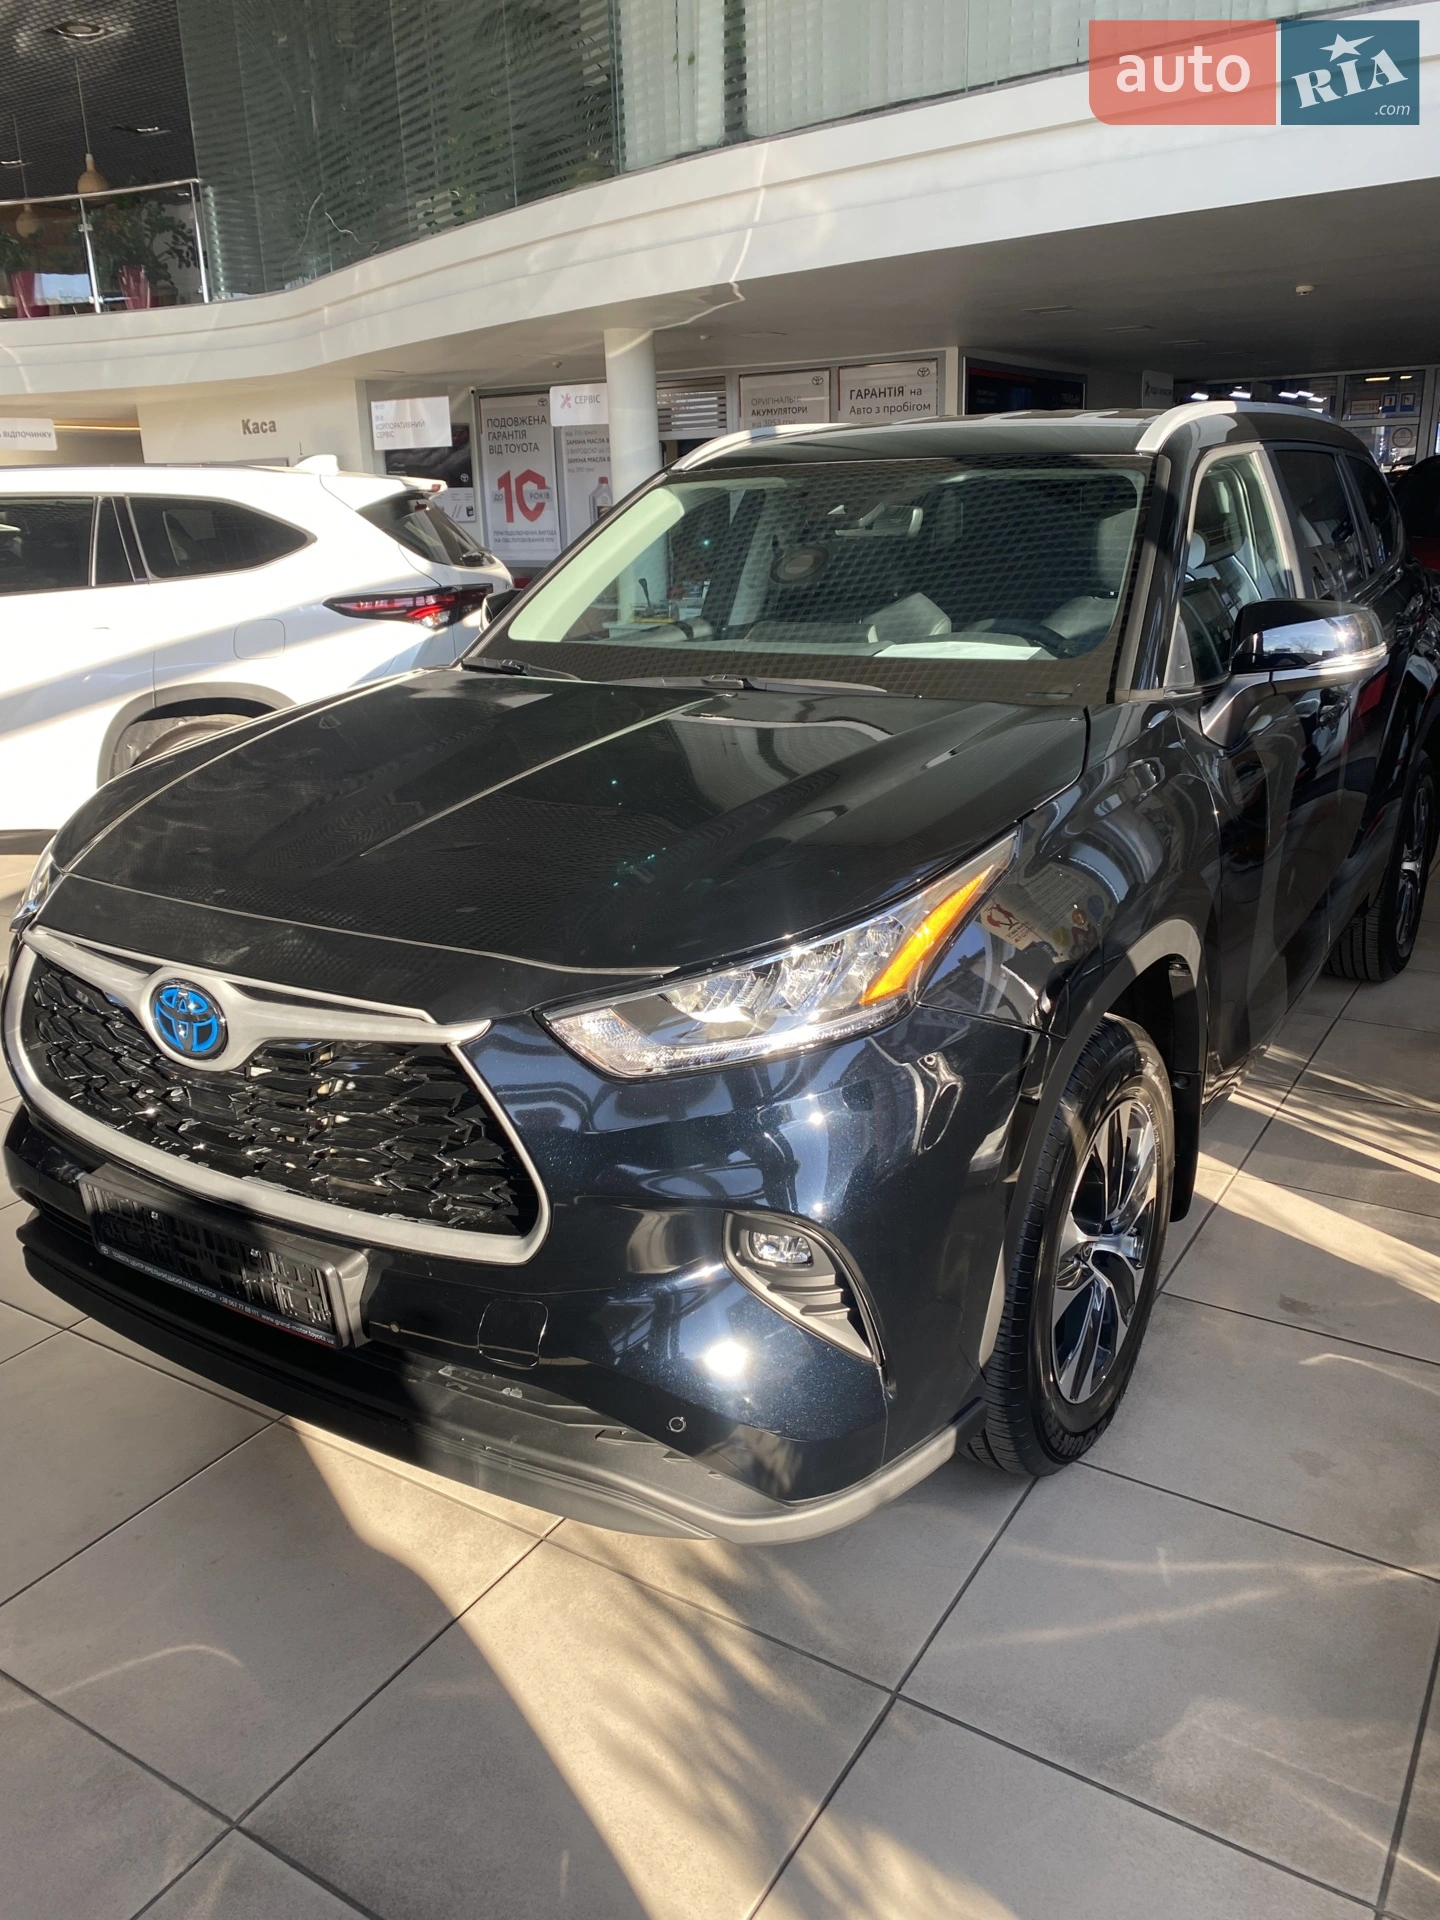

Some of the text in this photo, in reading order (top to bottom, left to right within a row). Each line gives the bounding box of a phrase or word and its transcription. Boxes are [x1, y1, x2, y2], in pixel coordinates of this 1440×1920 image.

[909, 387, 923, 397] на
[574, 394, 601, 405] СЕРВІС
[751, 406, 808, 417] АКУМУЛЯТОРИ
[849, 401, 931, 416] Авто з пробігом
[241, 418, 277, 435] Каса
[486, 414, 548, 428] ПОДОВЖЕНА
[2, 431, 52, 439] ВІДПОЧИНКУ
[487, 429, 527, 442] ГАРАНТІЯ
[488, 444, 503, 456] ВІД
